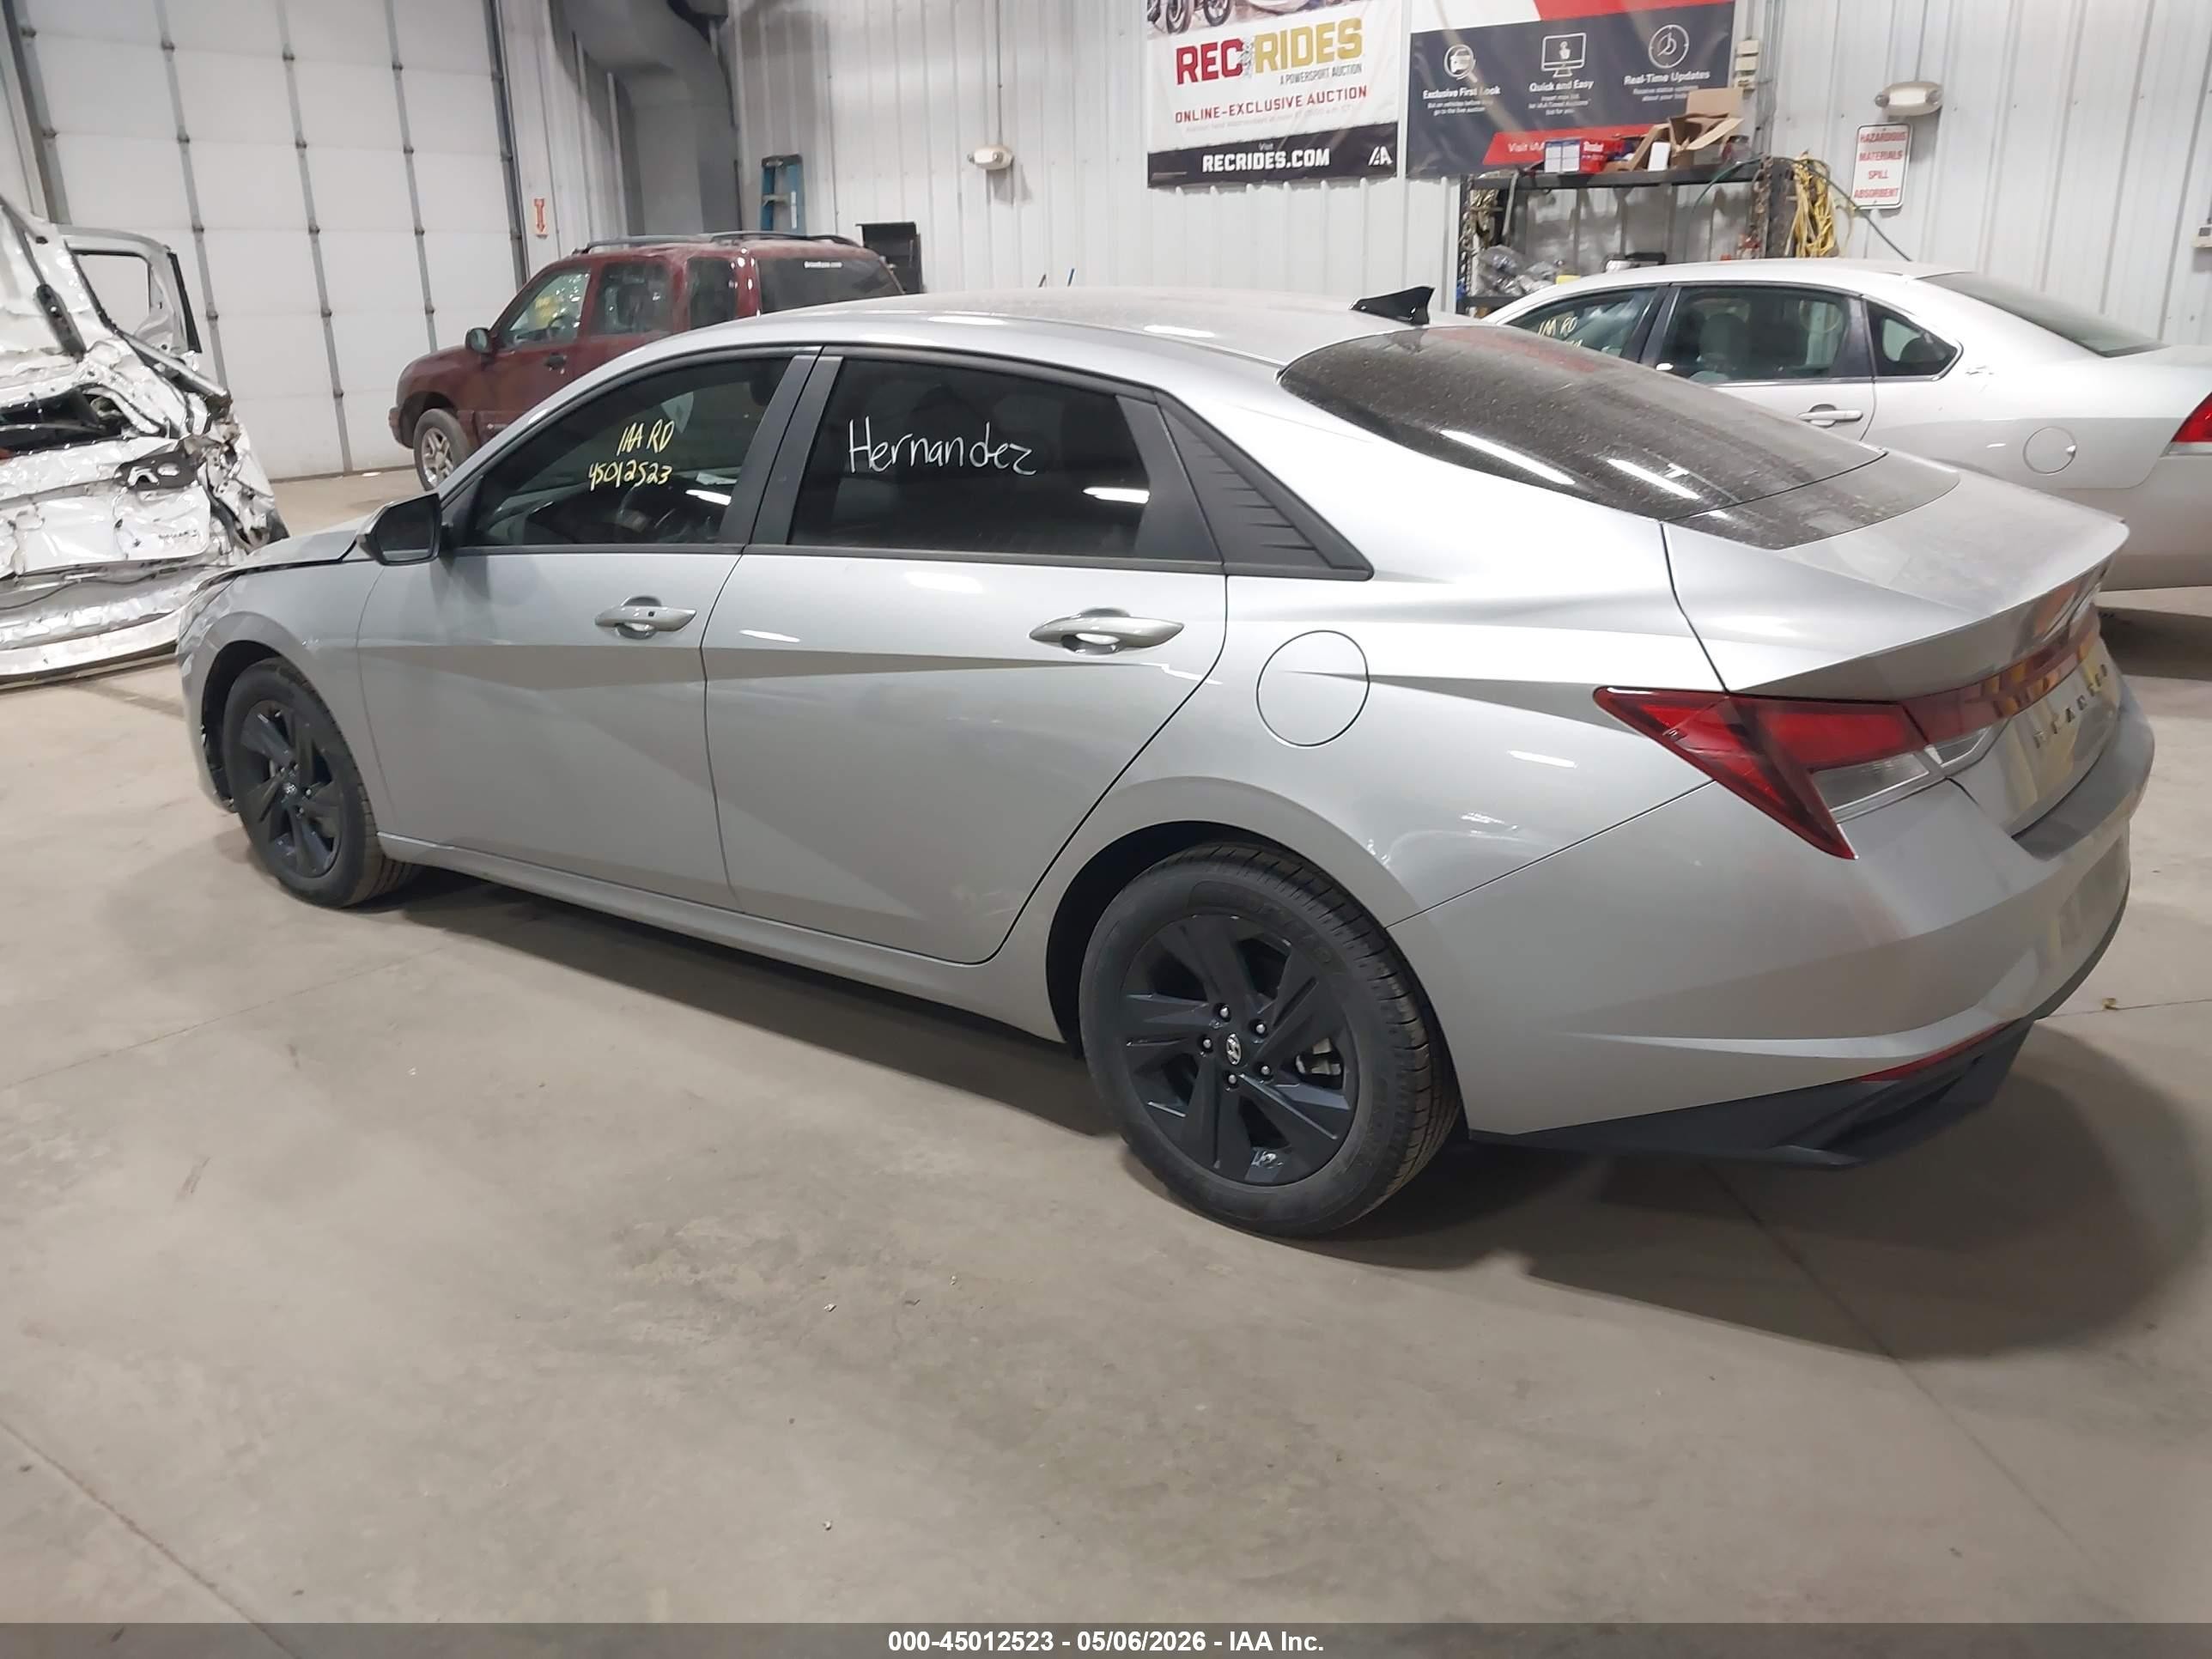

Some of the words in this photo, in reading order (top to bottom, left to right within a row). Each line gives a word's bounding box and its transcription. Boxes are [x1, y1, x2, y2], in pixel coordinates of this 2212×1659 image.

[1176, 38, 1244, 85] REC
[1254, 17, 1364, 74] RIDES
[1332, 64, 1363, 77] AUCTION
[1624, 72, 1668, 86] Real-Time
[1670, 70, 1711, 83] Updates
[1422, 88, 1458, 100] Exclusive
[1458, 88, 1478, 98] First
[1528, 82, 1554, 93] Quick
[1556, 80, 1572, 90] and
[1573, 79, 1595, 90] Easy
[1175, 94, 1303, 125] ONLINE-EXCLUSIVE
[1307, 85, 1368, 106] AUCTION
[1202, 149, 1330, 173] RECRIDES.COM
[647, 418, 676, 454] RD
[848, 416, 1037, 477] Hernandez
[587, 459, 672, 492] 45012523
